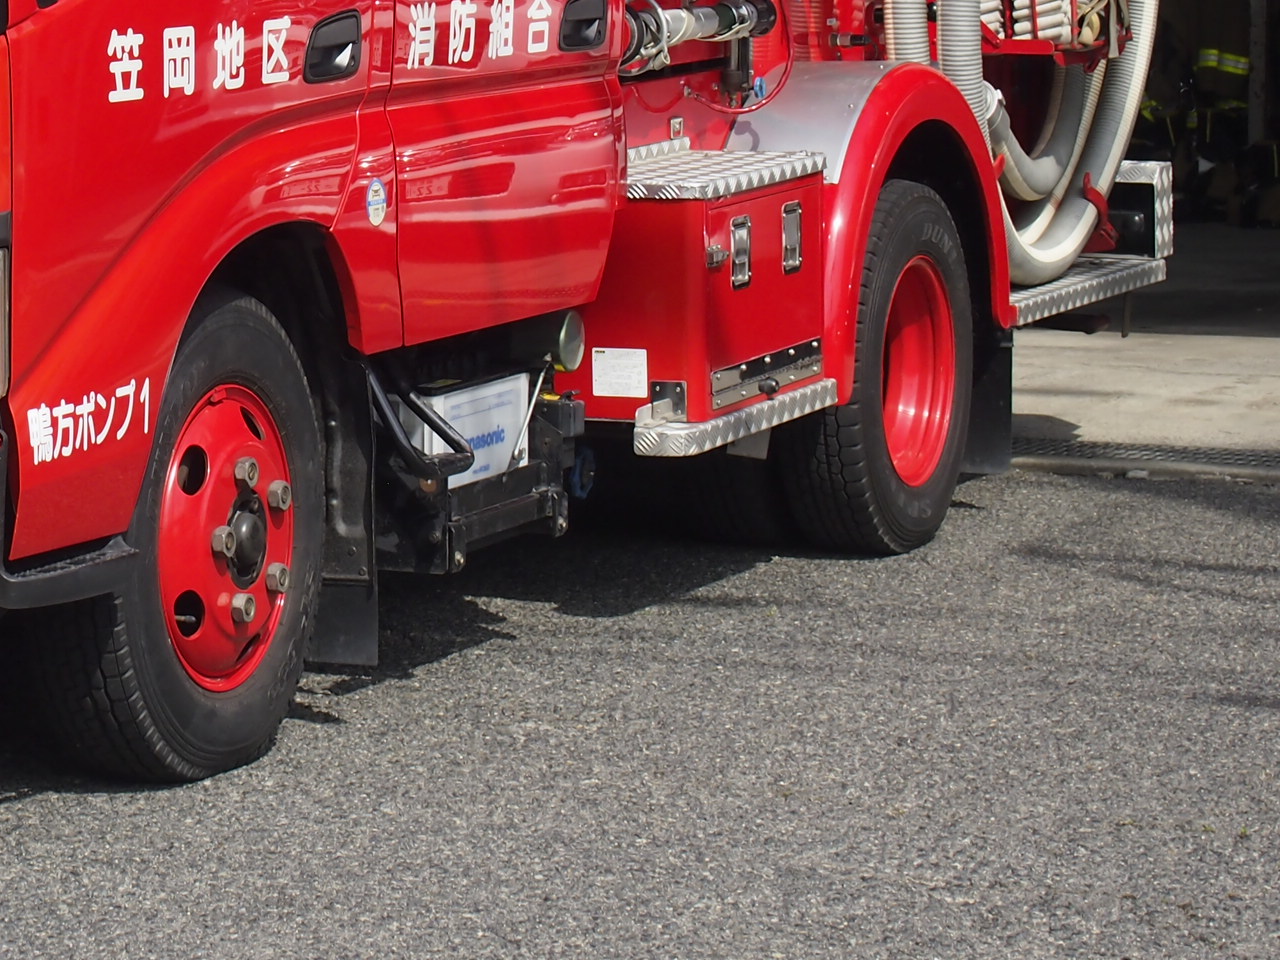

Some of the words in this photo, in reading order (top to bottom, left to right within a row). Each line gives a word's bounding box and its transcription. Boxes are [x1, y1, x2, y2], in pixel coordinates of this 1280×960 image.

[107, 15, 291, 103] 笠岡地区
[27, 377, 150, 465] 鴨方ポンプ1
[467, 424, 505, 450] nasonic
